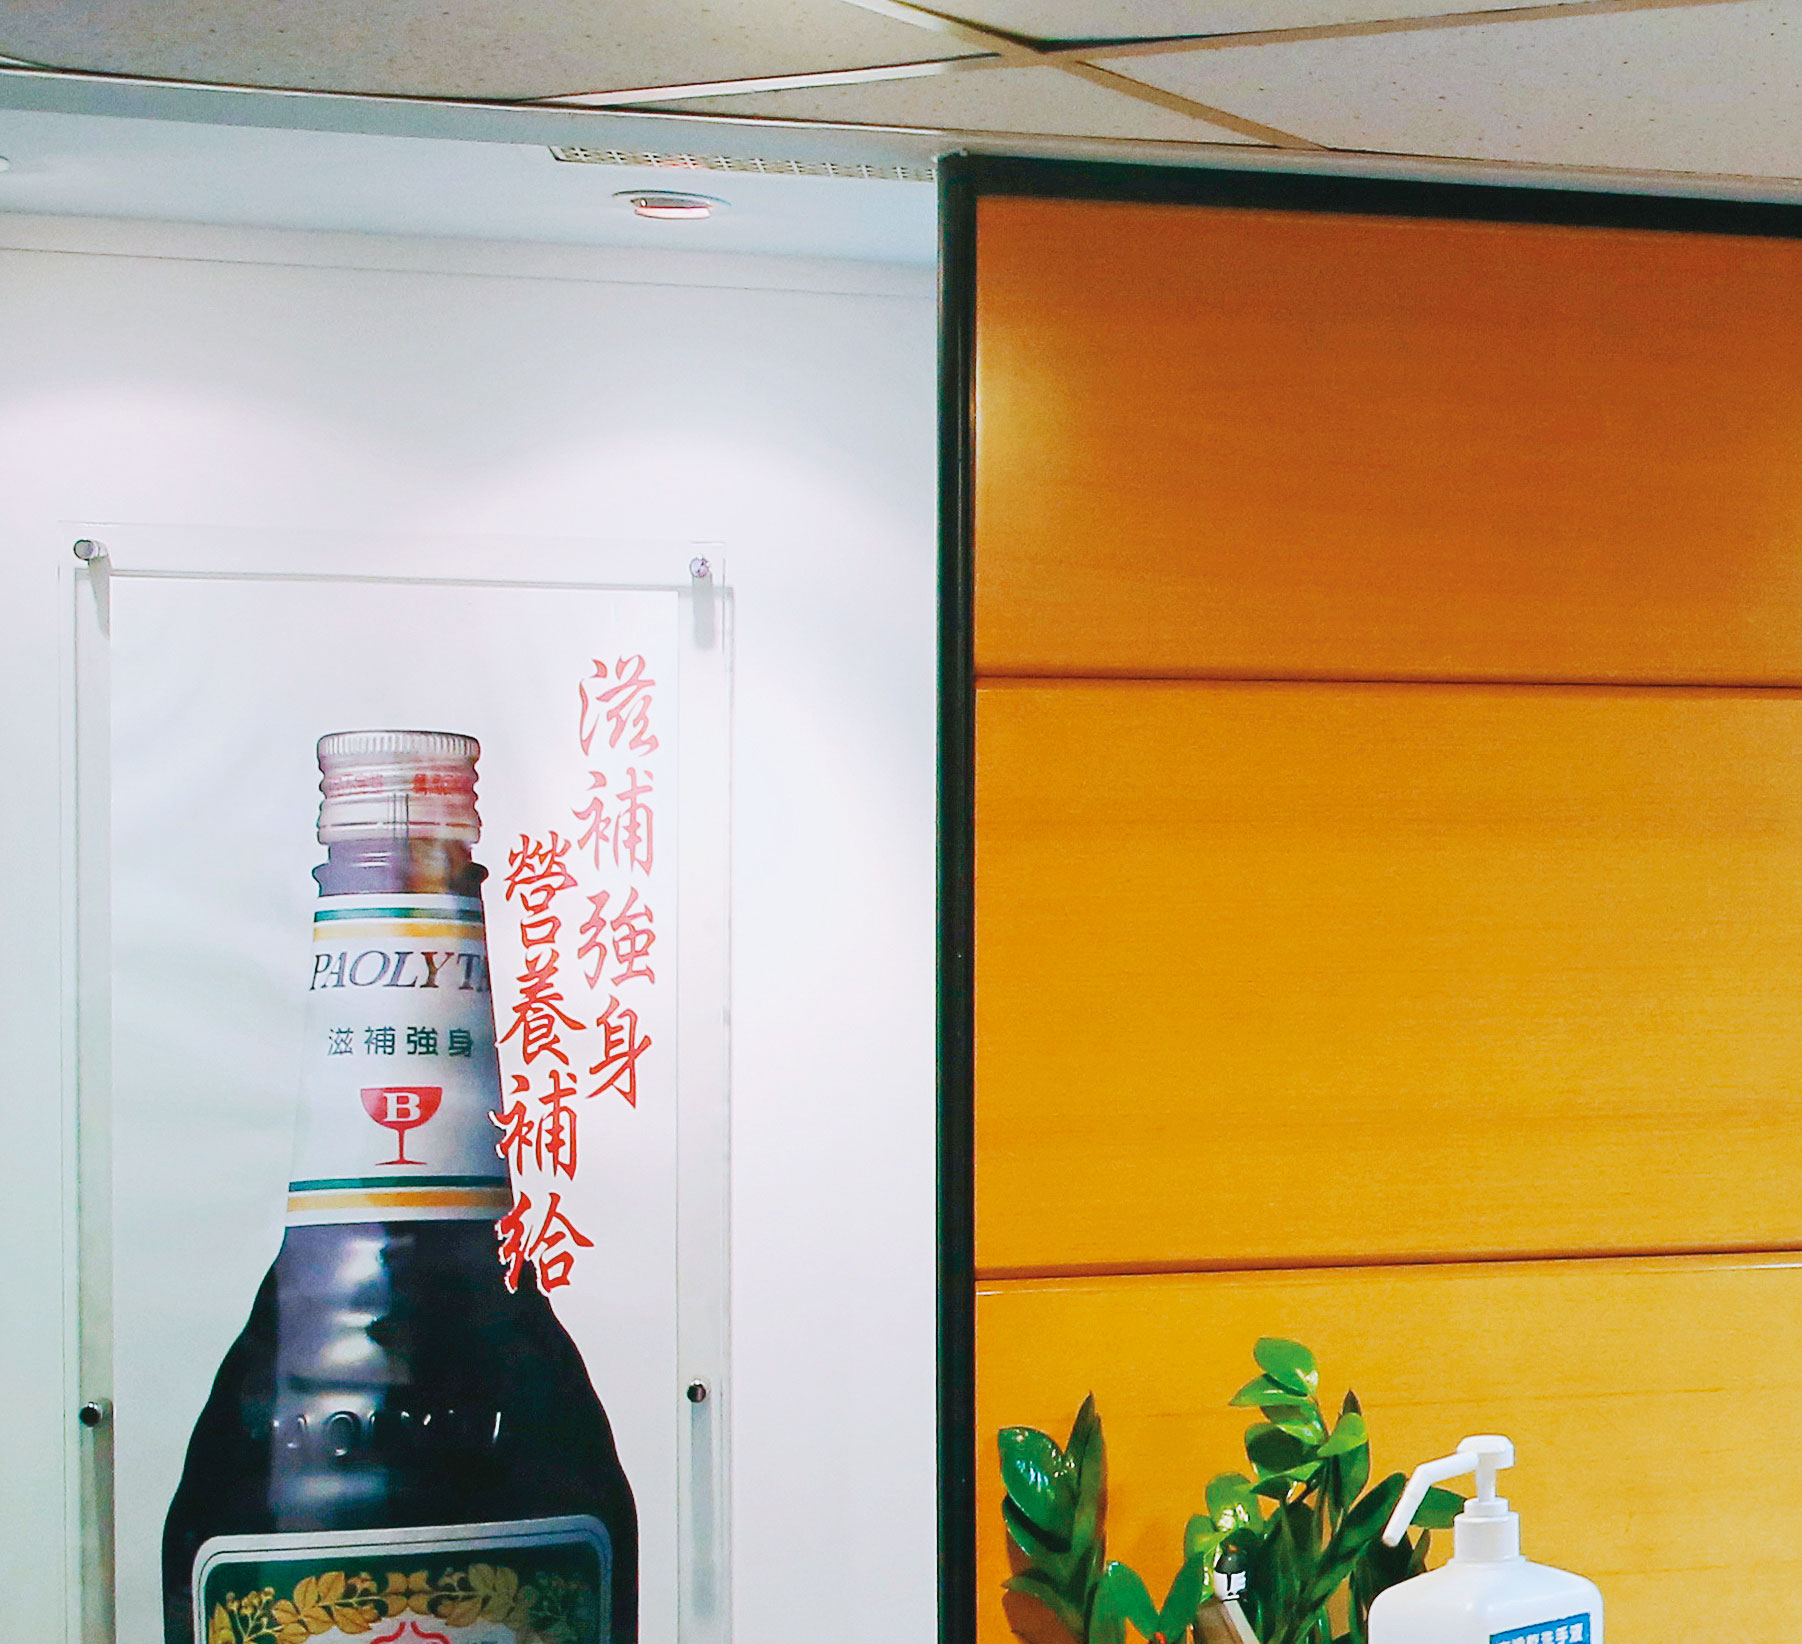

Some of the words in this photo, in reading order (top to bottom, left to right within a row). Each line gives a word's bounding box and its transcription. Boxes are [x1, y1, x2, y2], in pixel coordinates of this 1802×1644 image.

[572, 655, 660, 1108] 滋補強身
[327, 1026, 474, 1058] 滋補強身
[383, 1092, 421, 1122] B
[495, 832, 595, 1294] 營養補給
